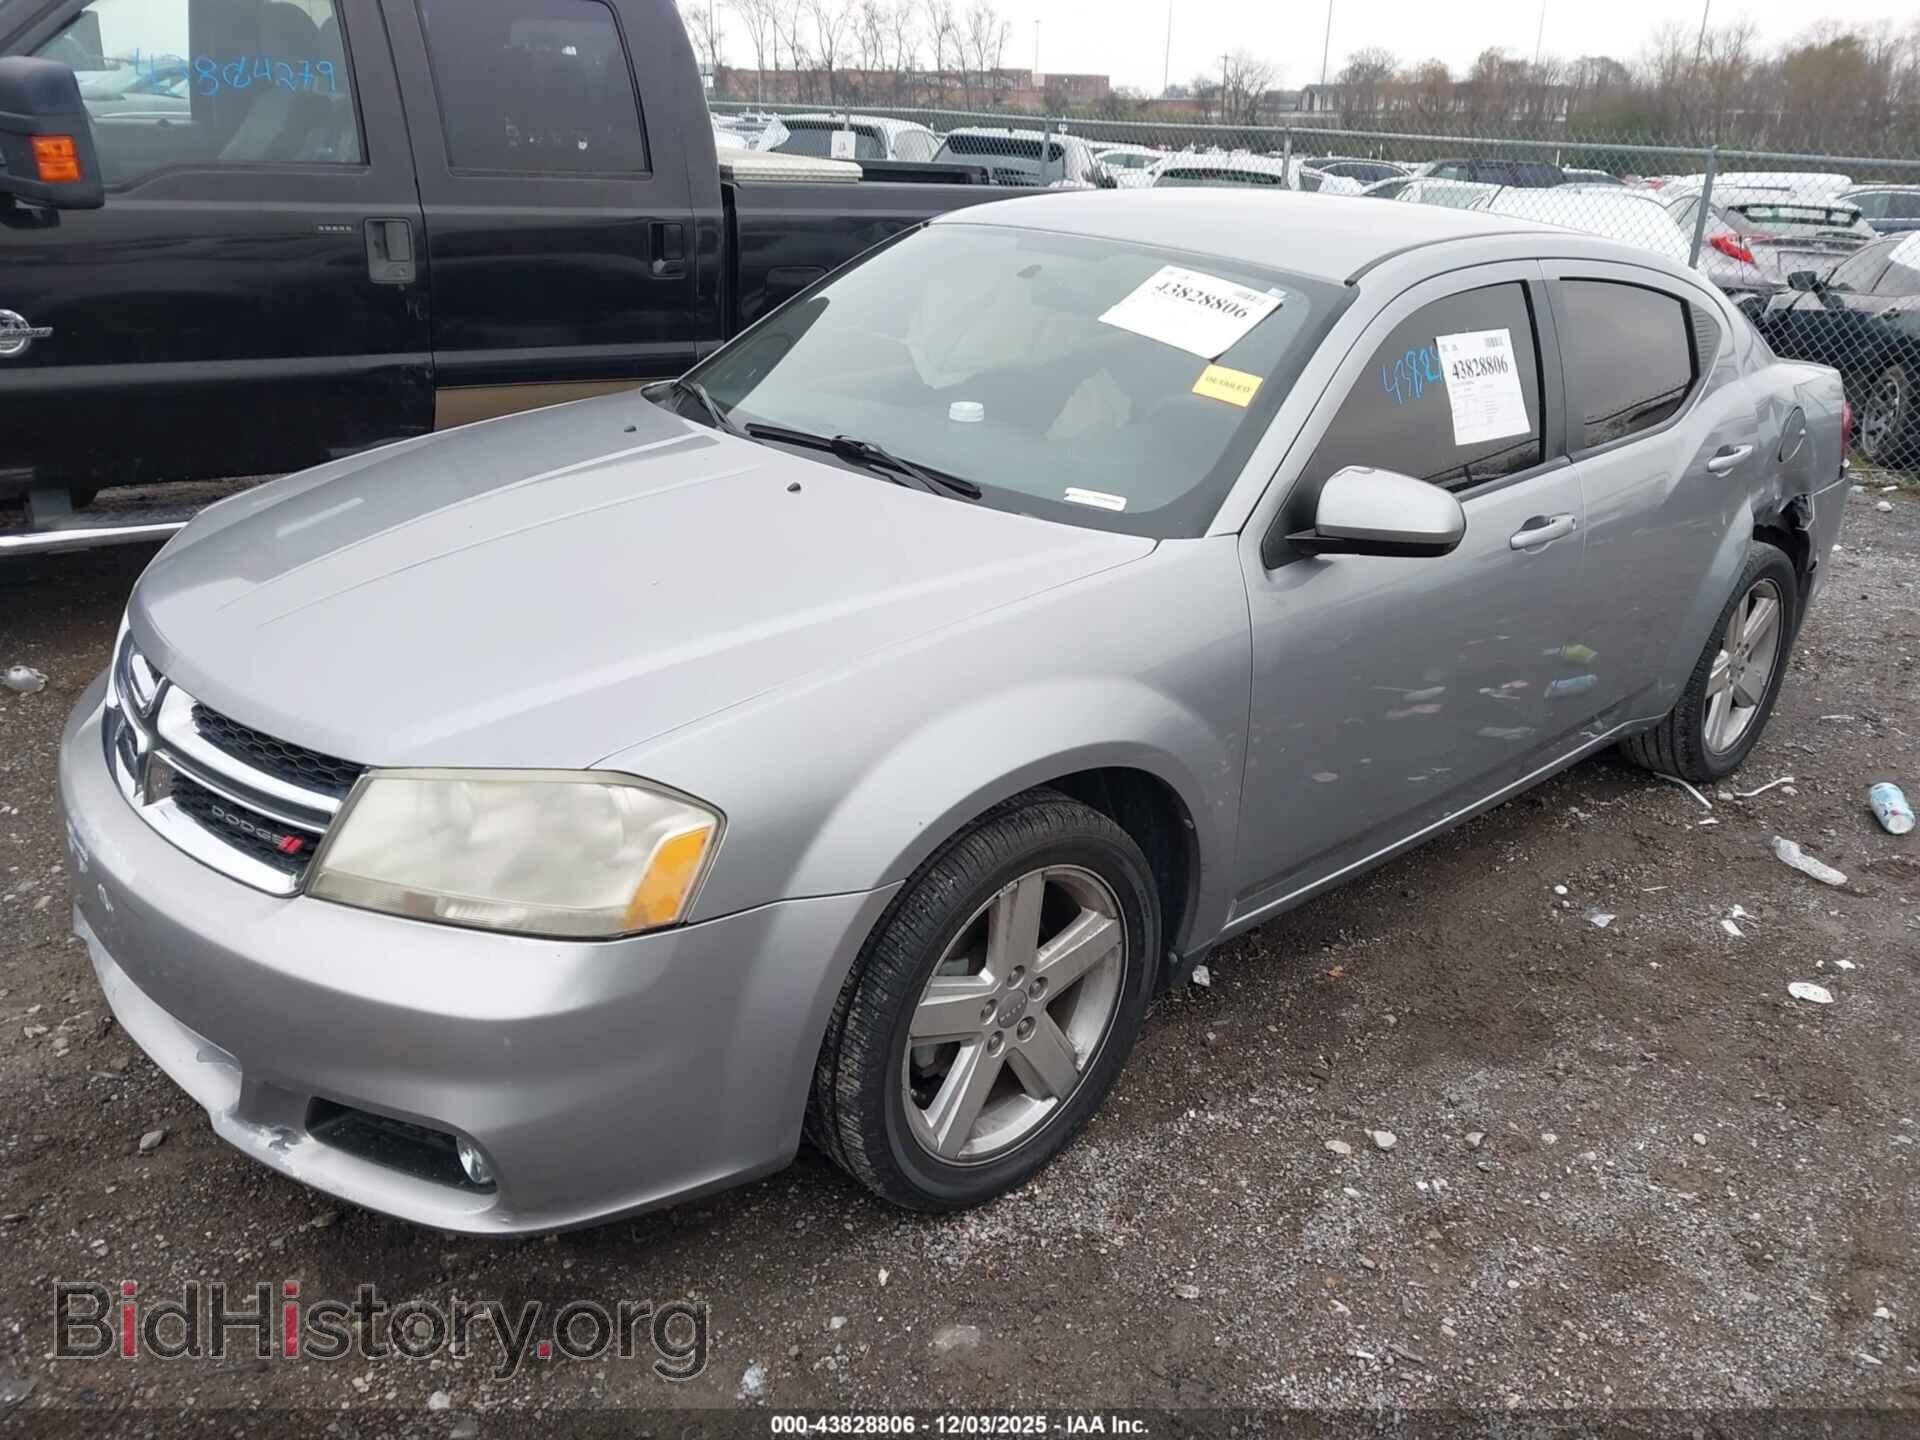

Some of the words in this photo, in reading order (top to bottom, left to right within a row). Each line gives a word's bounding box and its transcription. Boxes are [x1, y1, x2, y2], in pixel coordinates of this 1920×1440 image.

[1154, 281, 1248, 320] 43828806
[1452, 354, 1509, 381] 43828806
[1205, 375, 1251, 394] DETAILED
[211, 805, 284, 844] DODGE
